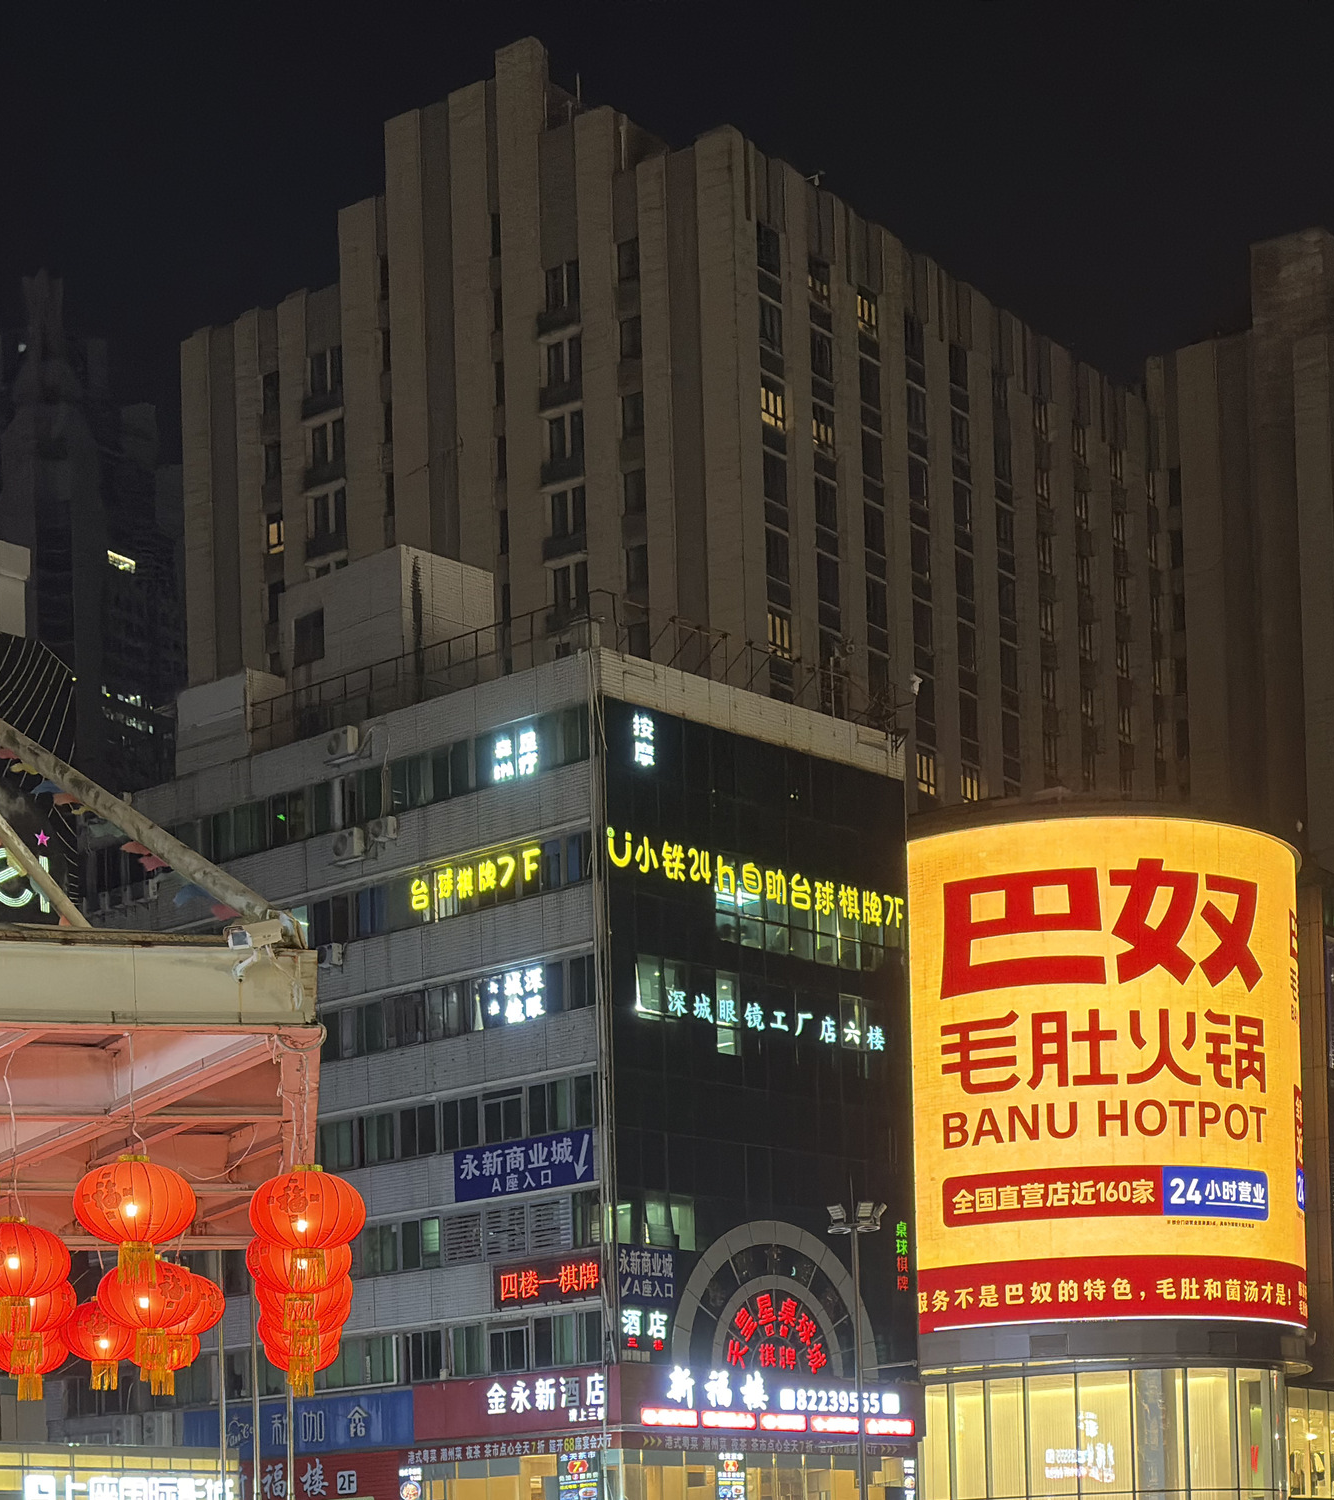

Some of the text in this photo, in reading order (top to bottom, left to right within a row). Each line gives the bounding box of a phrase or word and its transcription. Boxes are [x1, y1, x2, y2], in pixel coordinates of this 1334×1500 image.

[632, 711, 655, 767] 按摩
[940, 858, 1264, 1000] 巴奴
[667, 990, 886, 1051] 深城眼镜工厂店六楼
[940, 1009, 1267, 1095] 毛肚火锅
[942, 1101, 1079, 1150] BANU
[1098, 1099, 1267, 1144] HOTPOT
[459, 1137, 574, 1180] 永新商业城
[491, 1170, 552, 1193] A座入口
[951, 1179, 1156, 1215] 全国直营店近160家
[1170, 1177, 1266, 1205] 24小时营业
[619, 1248, 674, 1279] 永新商业城
[896, 1221, 909, 1292] 桌球棋牌
[621, 1309, 668, 1340] 酒店
[759, 1343, 796, 1371] 棋牌
[486, 1372, 605, 1415] 金永新酒店
[338, 1473, 355, 1493] 2F
